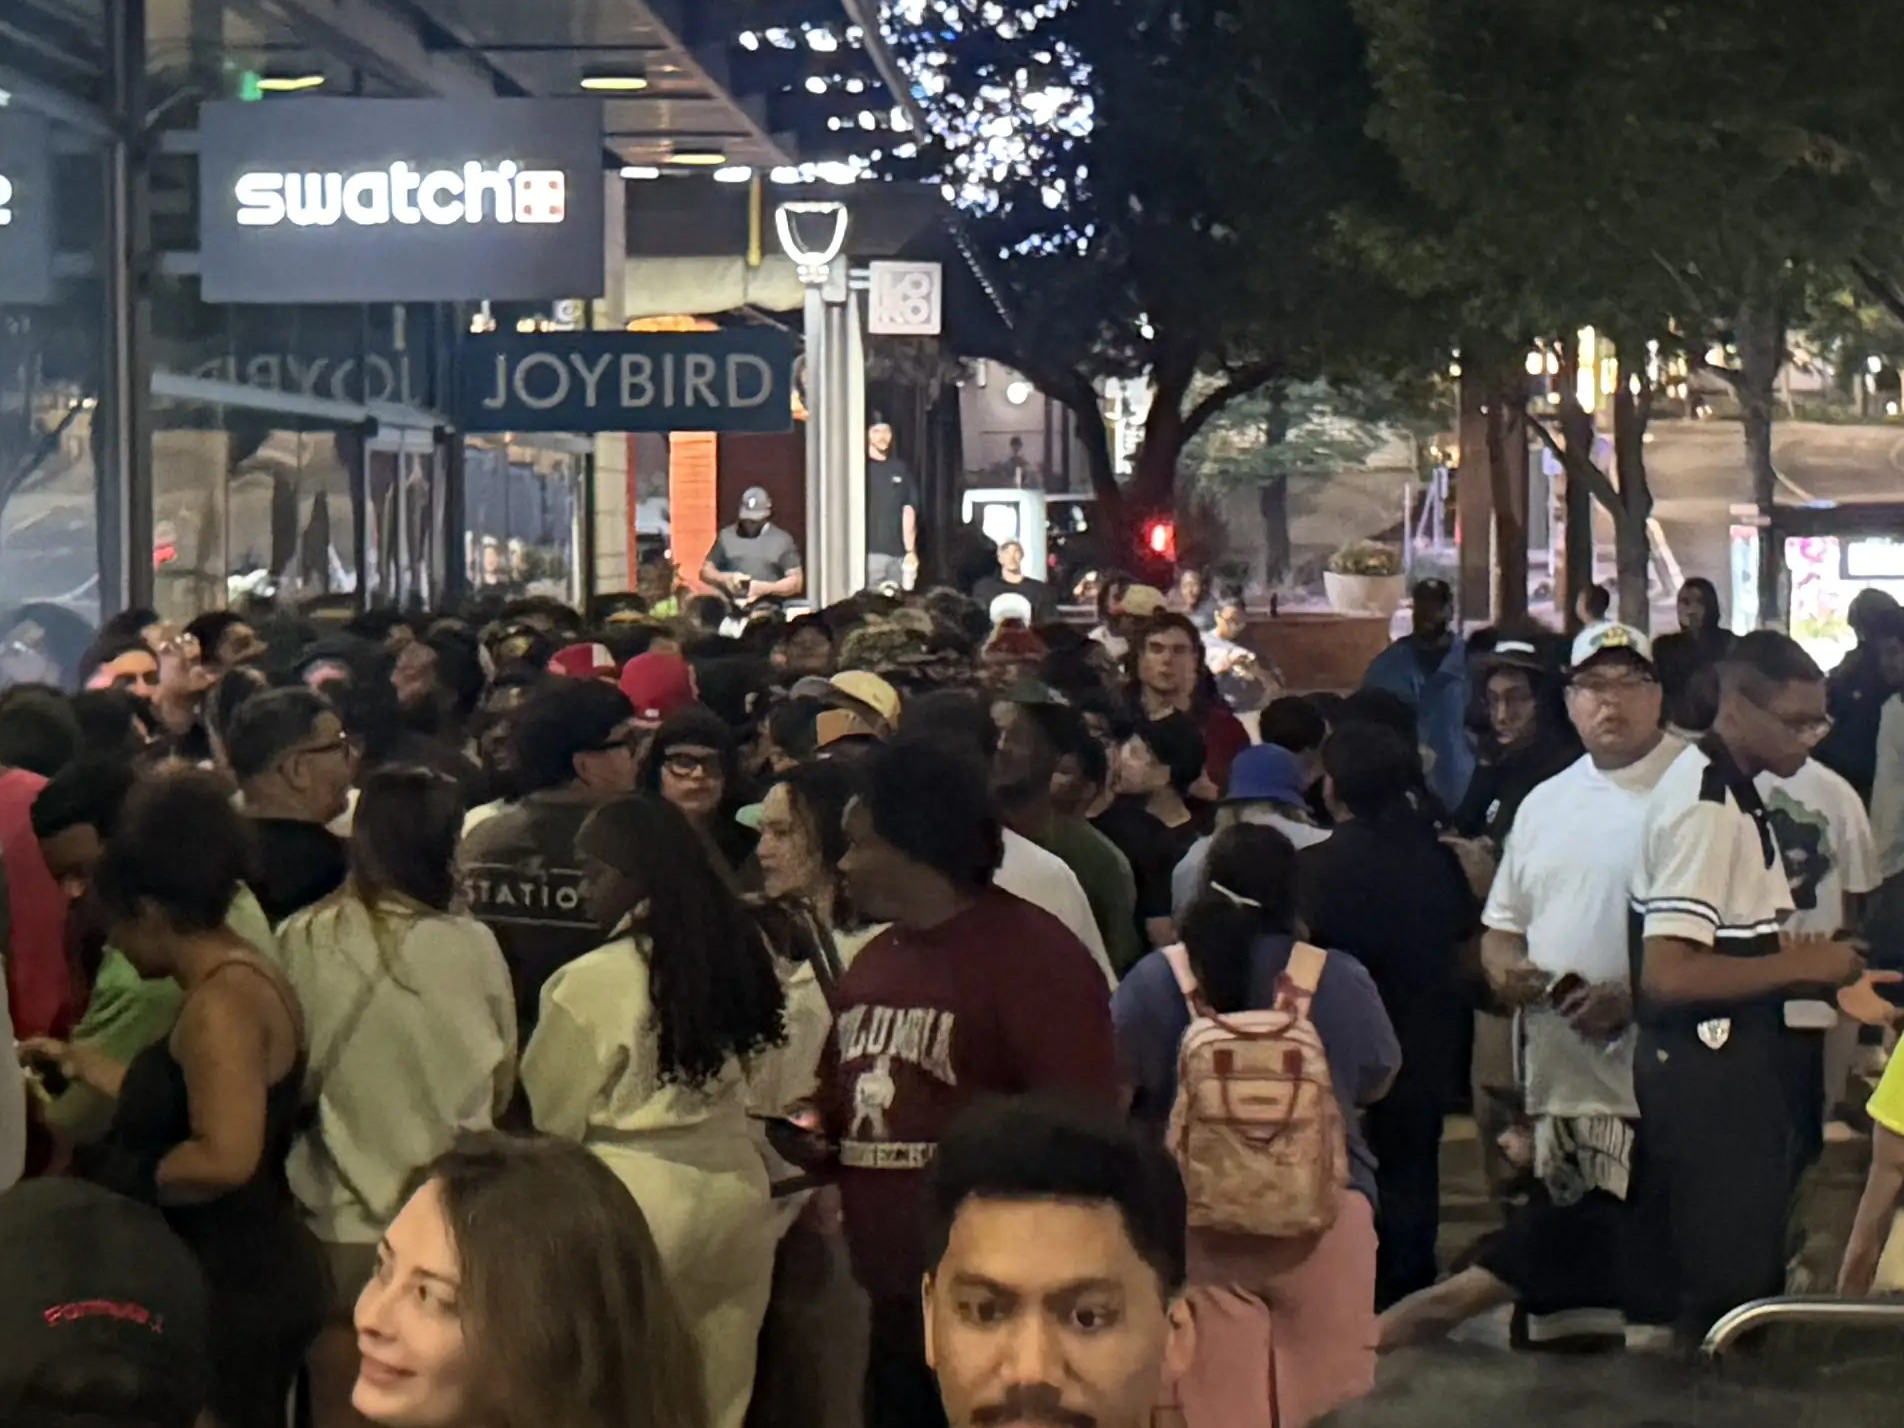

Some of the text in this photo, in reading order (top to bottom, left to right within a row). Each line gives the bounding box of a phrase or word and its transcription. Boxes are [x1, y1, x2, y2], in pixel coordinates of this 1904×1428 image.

[234, 160, 516, 225] swatch
[482, 351, 773, 410] JOYBIRD
[461, 879, 580, 911] STATIO
